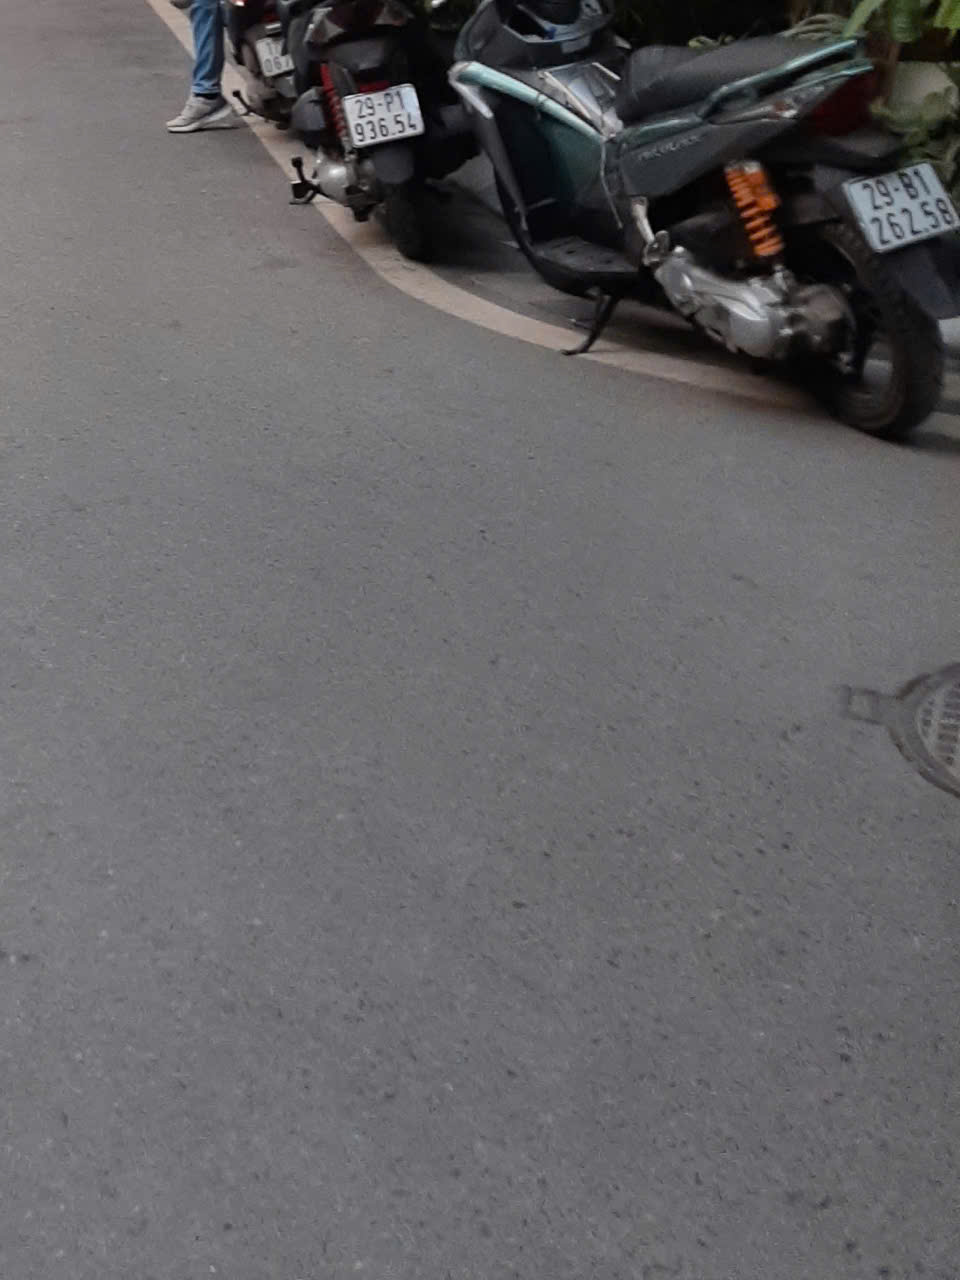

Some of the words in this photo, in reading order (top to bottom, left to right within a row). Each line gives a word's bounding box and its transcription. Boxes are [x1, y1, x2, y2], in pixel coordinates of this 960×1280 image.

[355, 90, 405, 119] 29-P1
[355, 114, 417, 142] 936.54
[862, 169, 931, 210] 29-B1
[871, 197, 954, 245] 262.58
